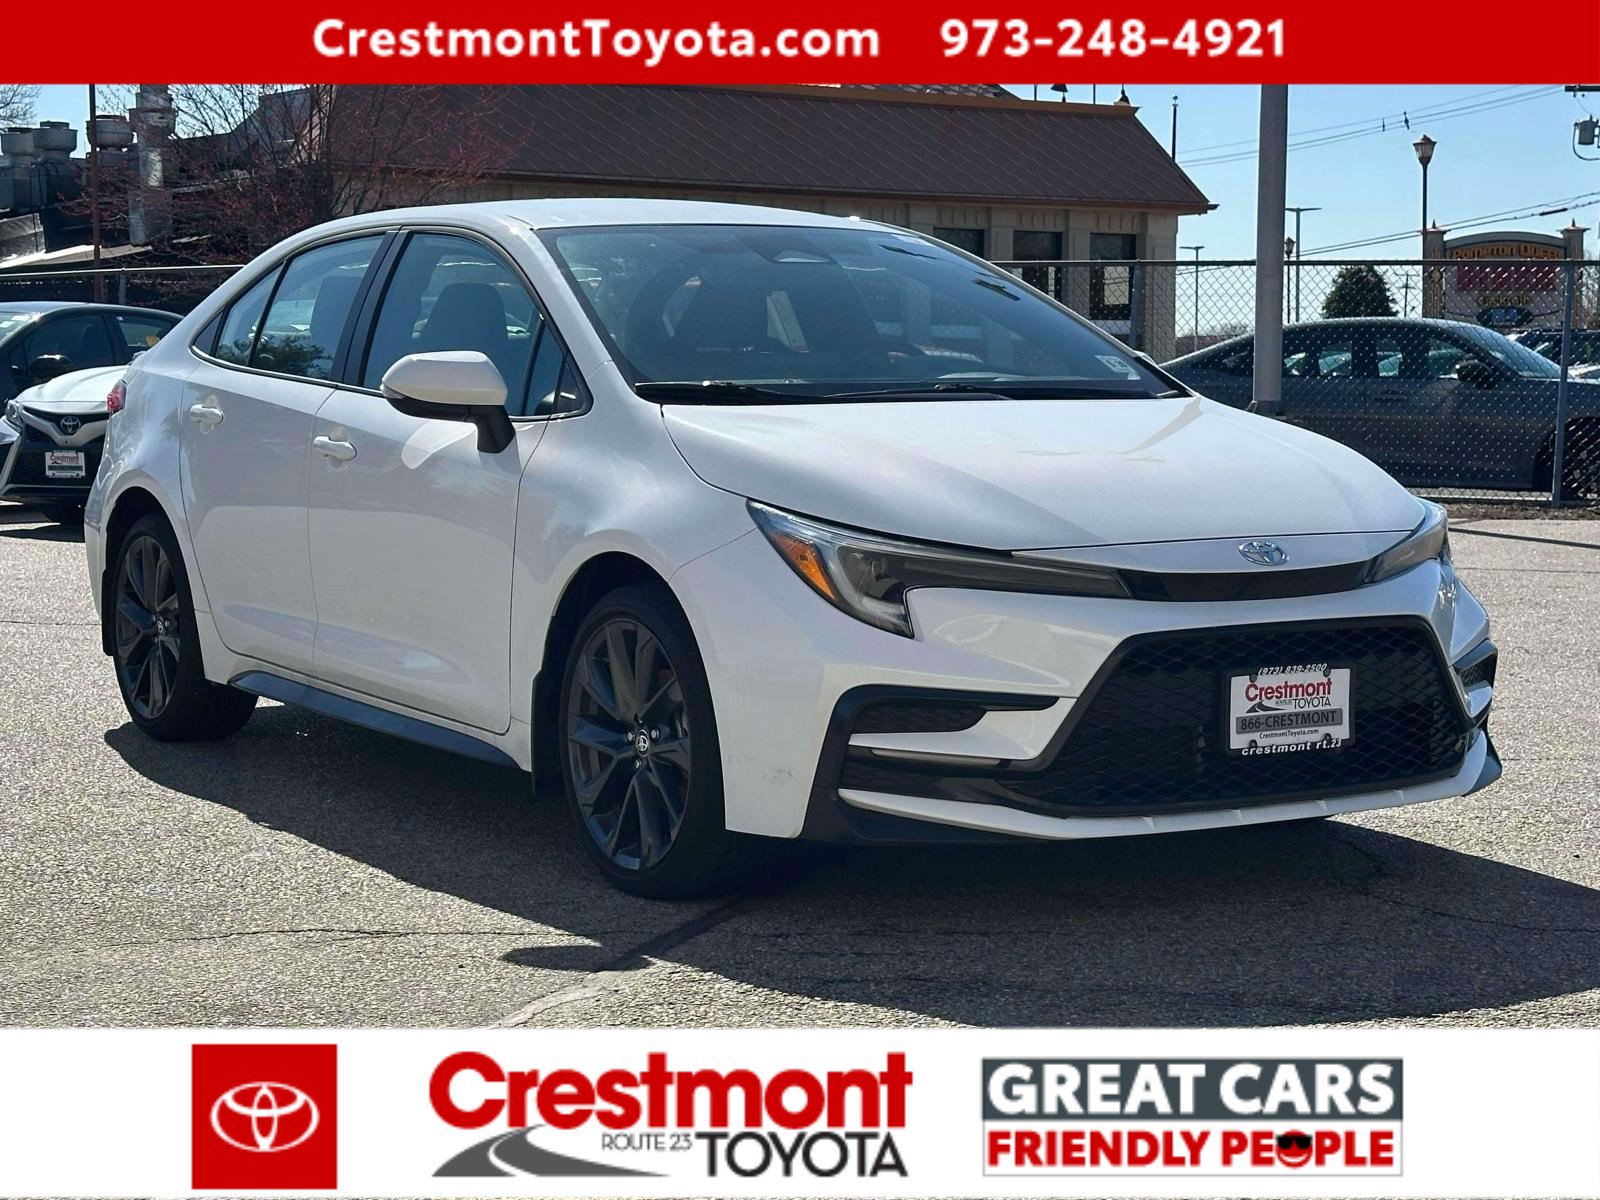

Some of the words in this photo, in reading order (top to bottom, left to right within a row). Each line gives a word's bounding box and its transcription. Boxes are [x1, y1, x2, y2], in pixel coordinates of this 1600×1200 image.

[1245, 677, 1332, 702] Crestmont
[1293, 696, 1331, 709] TOYOTA
[1240, 710, 1337, 731] 866-CRESTMONT
[1259, 729, 1320, 739] CrestmontToyota.com
[1241, 741, 1311, 756] crestmont
